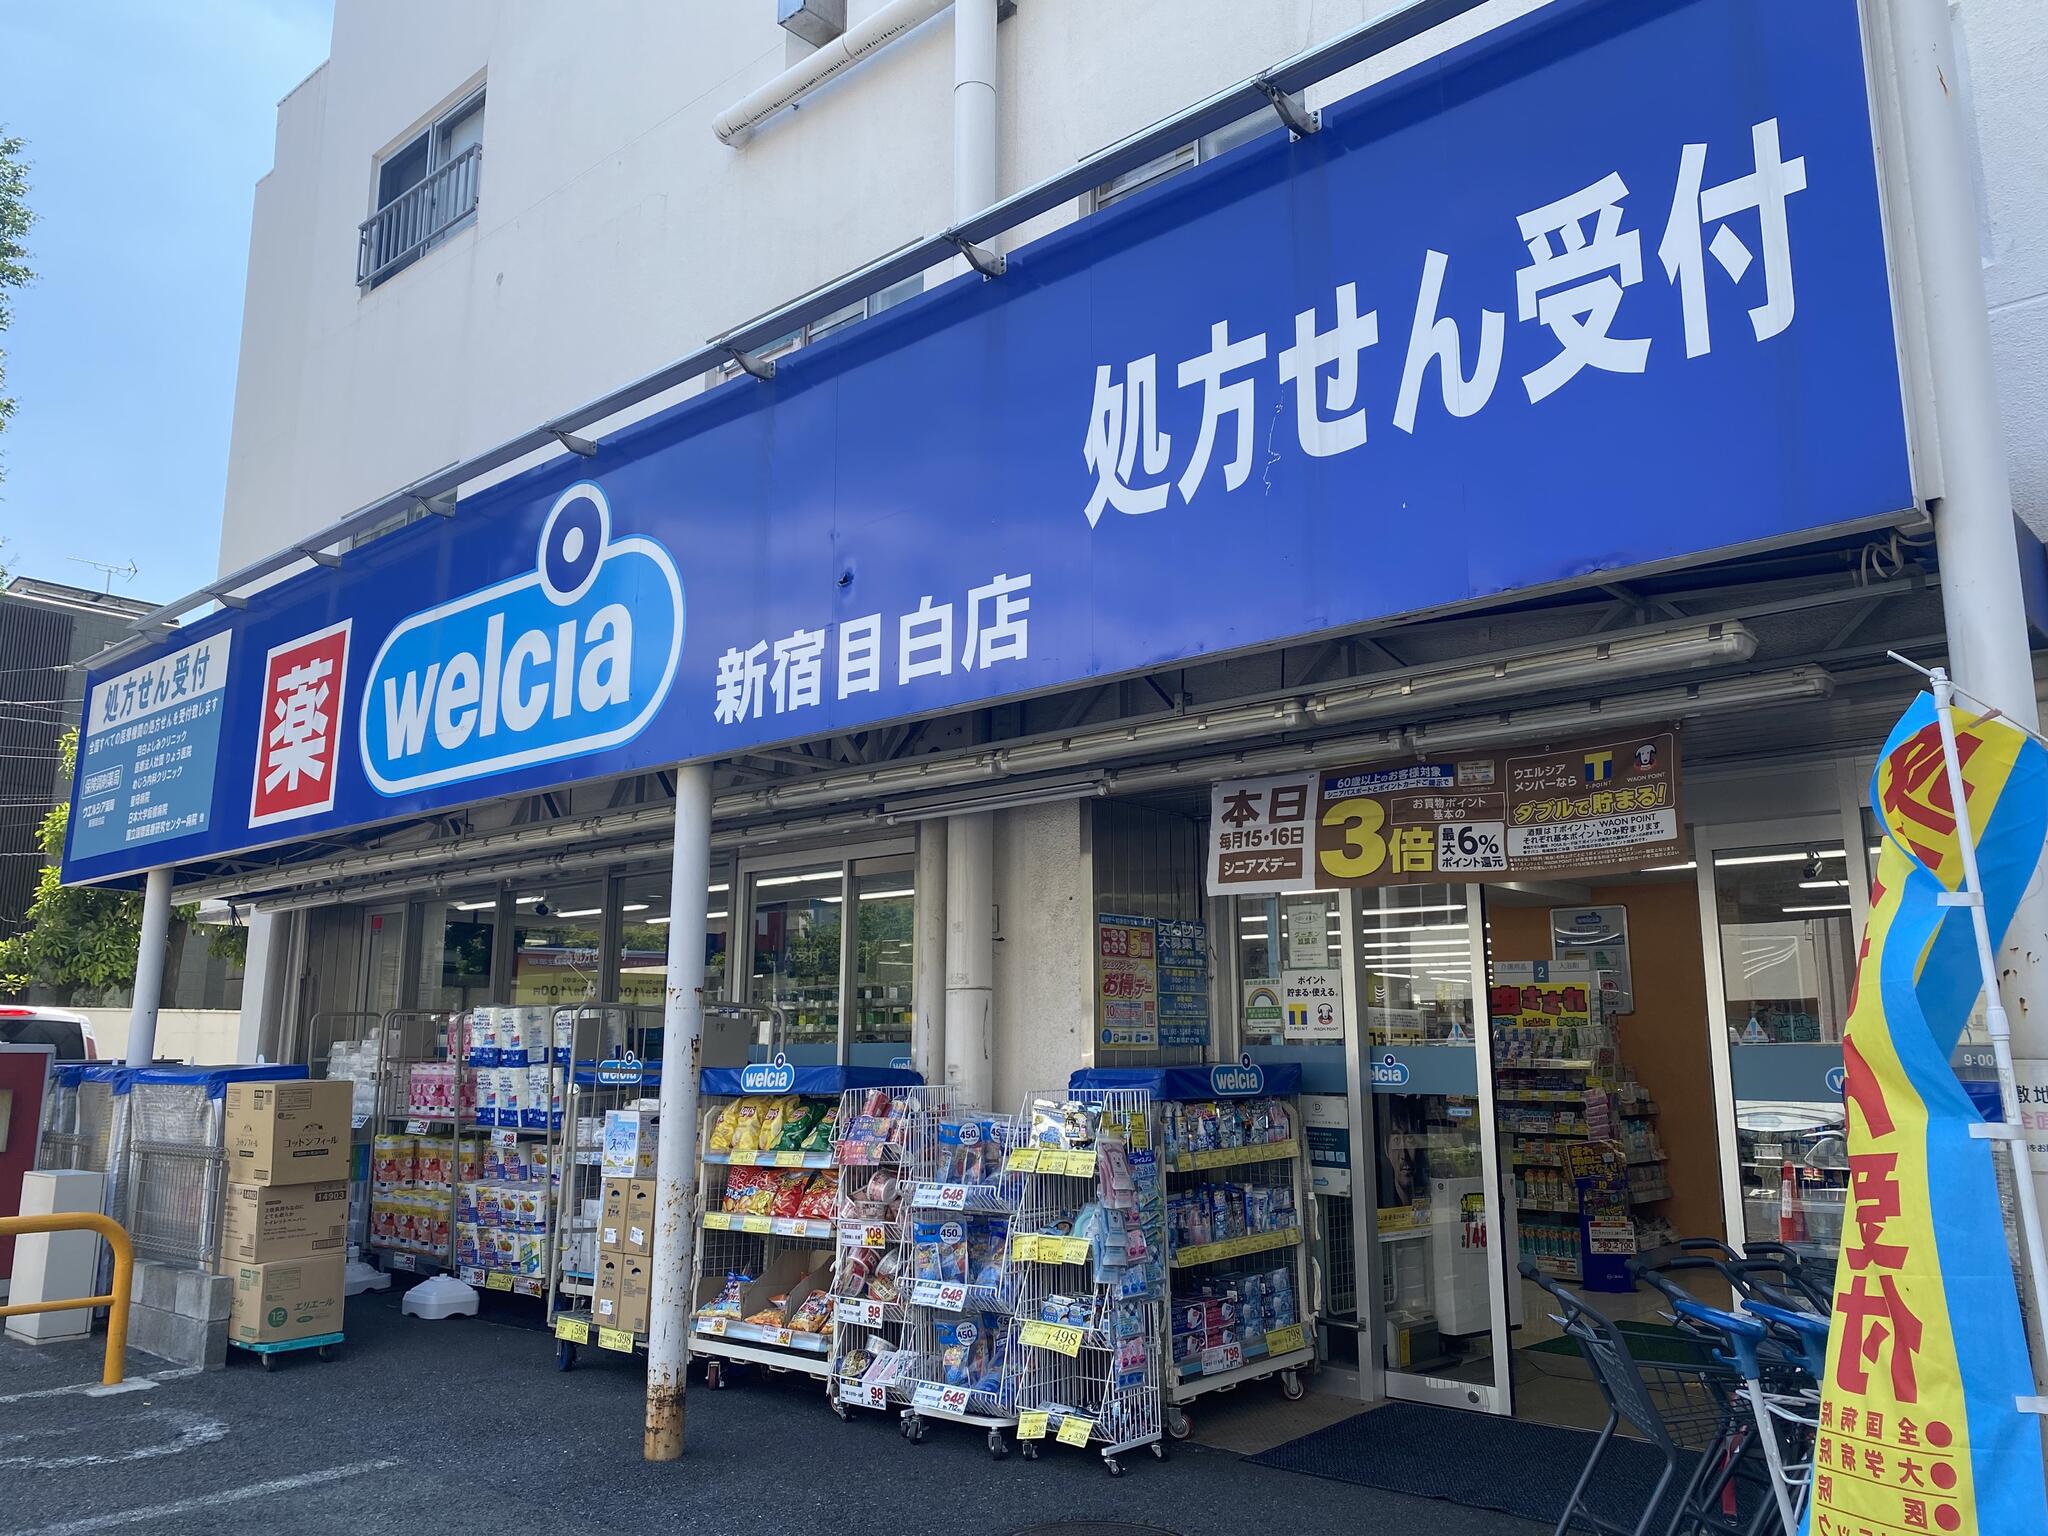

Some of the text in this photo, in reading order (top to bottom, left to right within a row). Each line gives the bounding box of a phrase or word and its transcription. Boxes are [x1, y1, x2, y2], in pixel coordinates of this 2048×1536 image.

[1084, 117, 1808, 529] 処方せん受付
[714, 573, 1032, 724] 新宿目白店
[103, 645, 211, 725] 処方せん受付
[383, 602, 634, 761] welcia
[264, 657, 334, 795] 薬
[1337, 765, 1441, 789] 60歳以上のお客様対象
[1514, 764, 1566, 780] ウエルシア
[1514, 776, 1577, 793] メンバーなら
[1221, 784, 1309, 829] 本日
[1412, 797, 1487, 810] お買物ポイント
[1433, 808, 1466, 821] 基本の
[1457, 826, 1500, 856] 6%
[1224, 856, 1297, 877] シニアズデー
[1442, 856, 1504, 869] ポイント還元
[1537, 966, 1545, 978] 2
[1297, 976, 1326, 985] ポイント
[1963, 1054, 1994, 1066] 9:00
[745, 1068, 788, 1087] welcia
[1216, 1069, 1258, 1089] welcia
[1371, 1066, 1402, 1082] elcia
[959, 1129, 977, 1139] 450
[318, 1191, 345, 1201] 14903
[942, 1188, 964, 1201] 648
[865, 1227, 882, 1239] 108
[940, 1229, 957, 1238] 450
[941, 1287, 964, 1301] 648
[294, 1297, 336, 1311] エリエール
[271, 1311, 285, 1321] 12
[867, 1305, 881, 1318] 98
[1052, 1328, 1079, 1346] 498
[1223, 1347, 1240, 1360] 798
[870, 1387, 884, 1400] 98
[943, 1390, 966, 1404] 648
